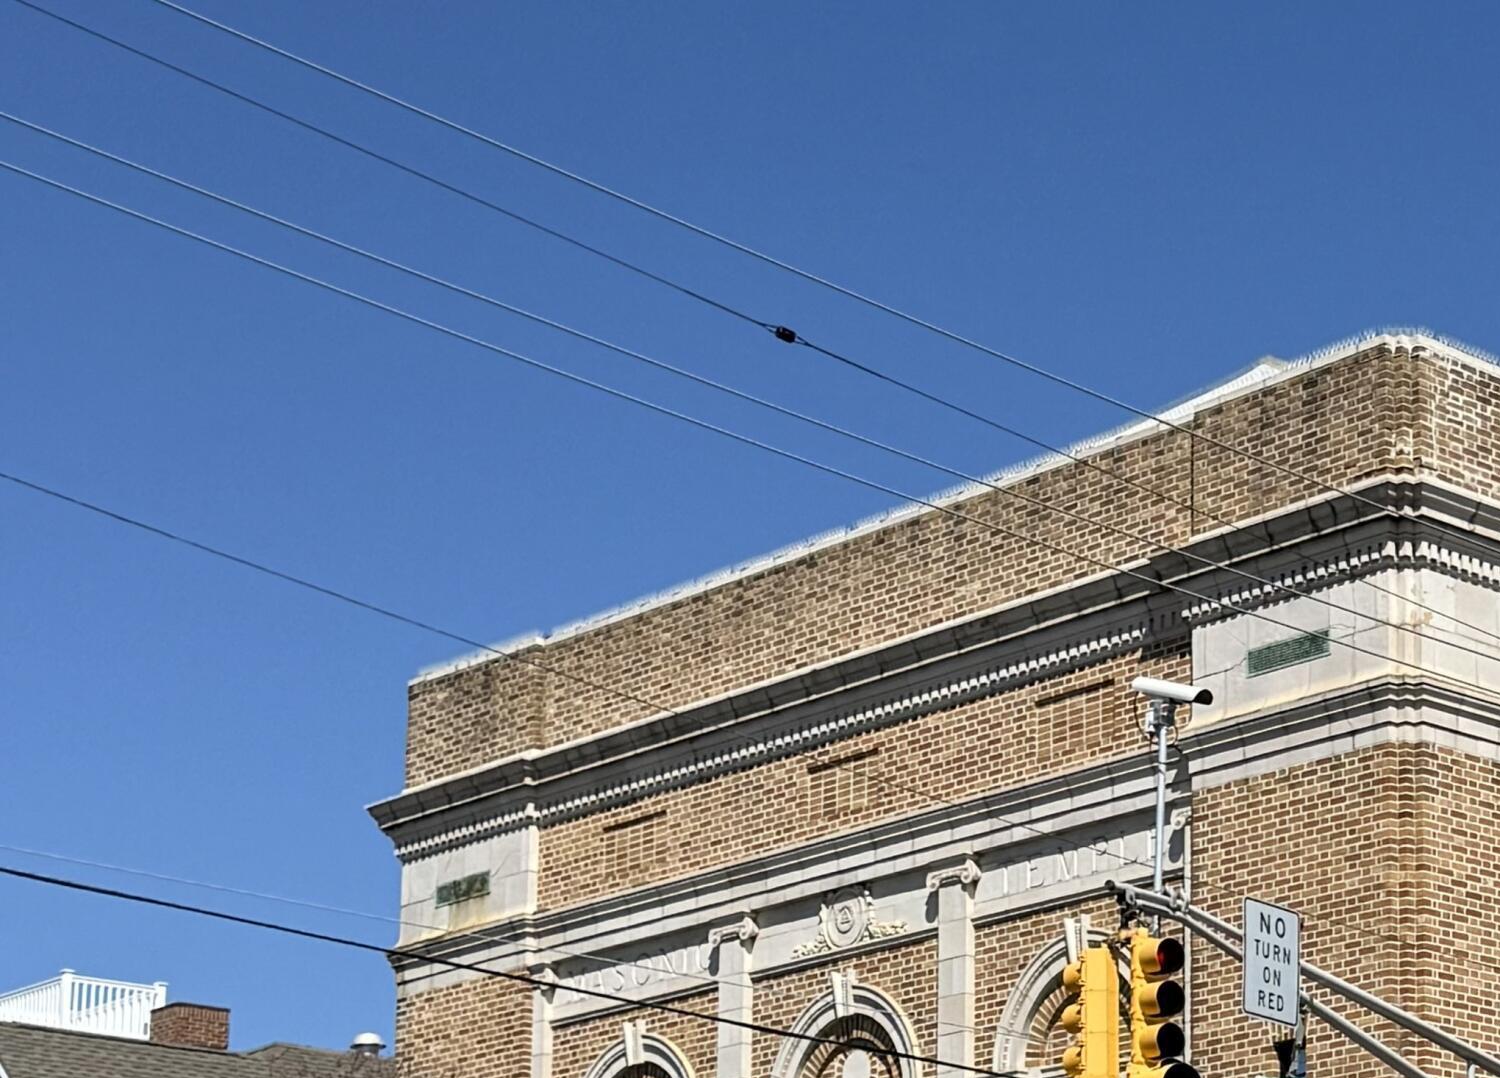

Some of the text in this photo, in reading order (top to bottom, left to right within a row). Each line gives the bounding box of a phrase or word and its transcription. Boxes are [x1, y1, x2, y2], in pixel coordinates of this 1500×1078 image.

[566, 823, 1161, 1004] MASONIC TEMPLE
[1260, 912, 1286, 938] NO
[1254, 939, 1291, 966] TURN
[1263, 966, 1281, 987] ON
[1258, 990, 1284, 1012] RED
